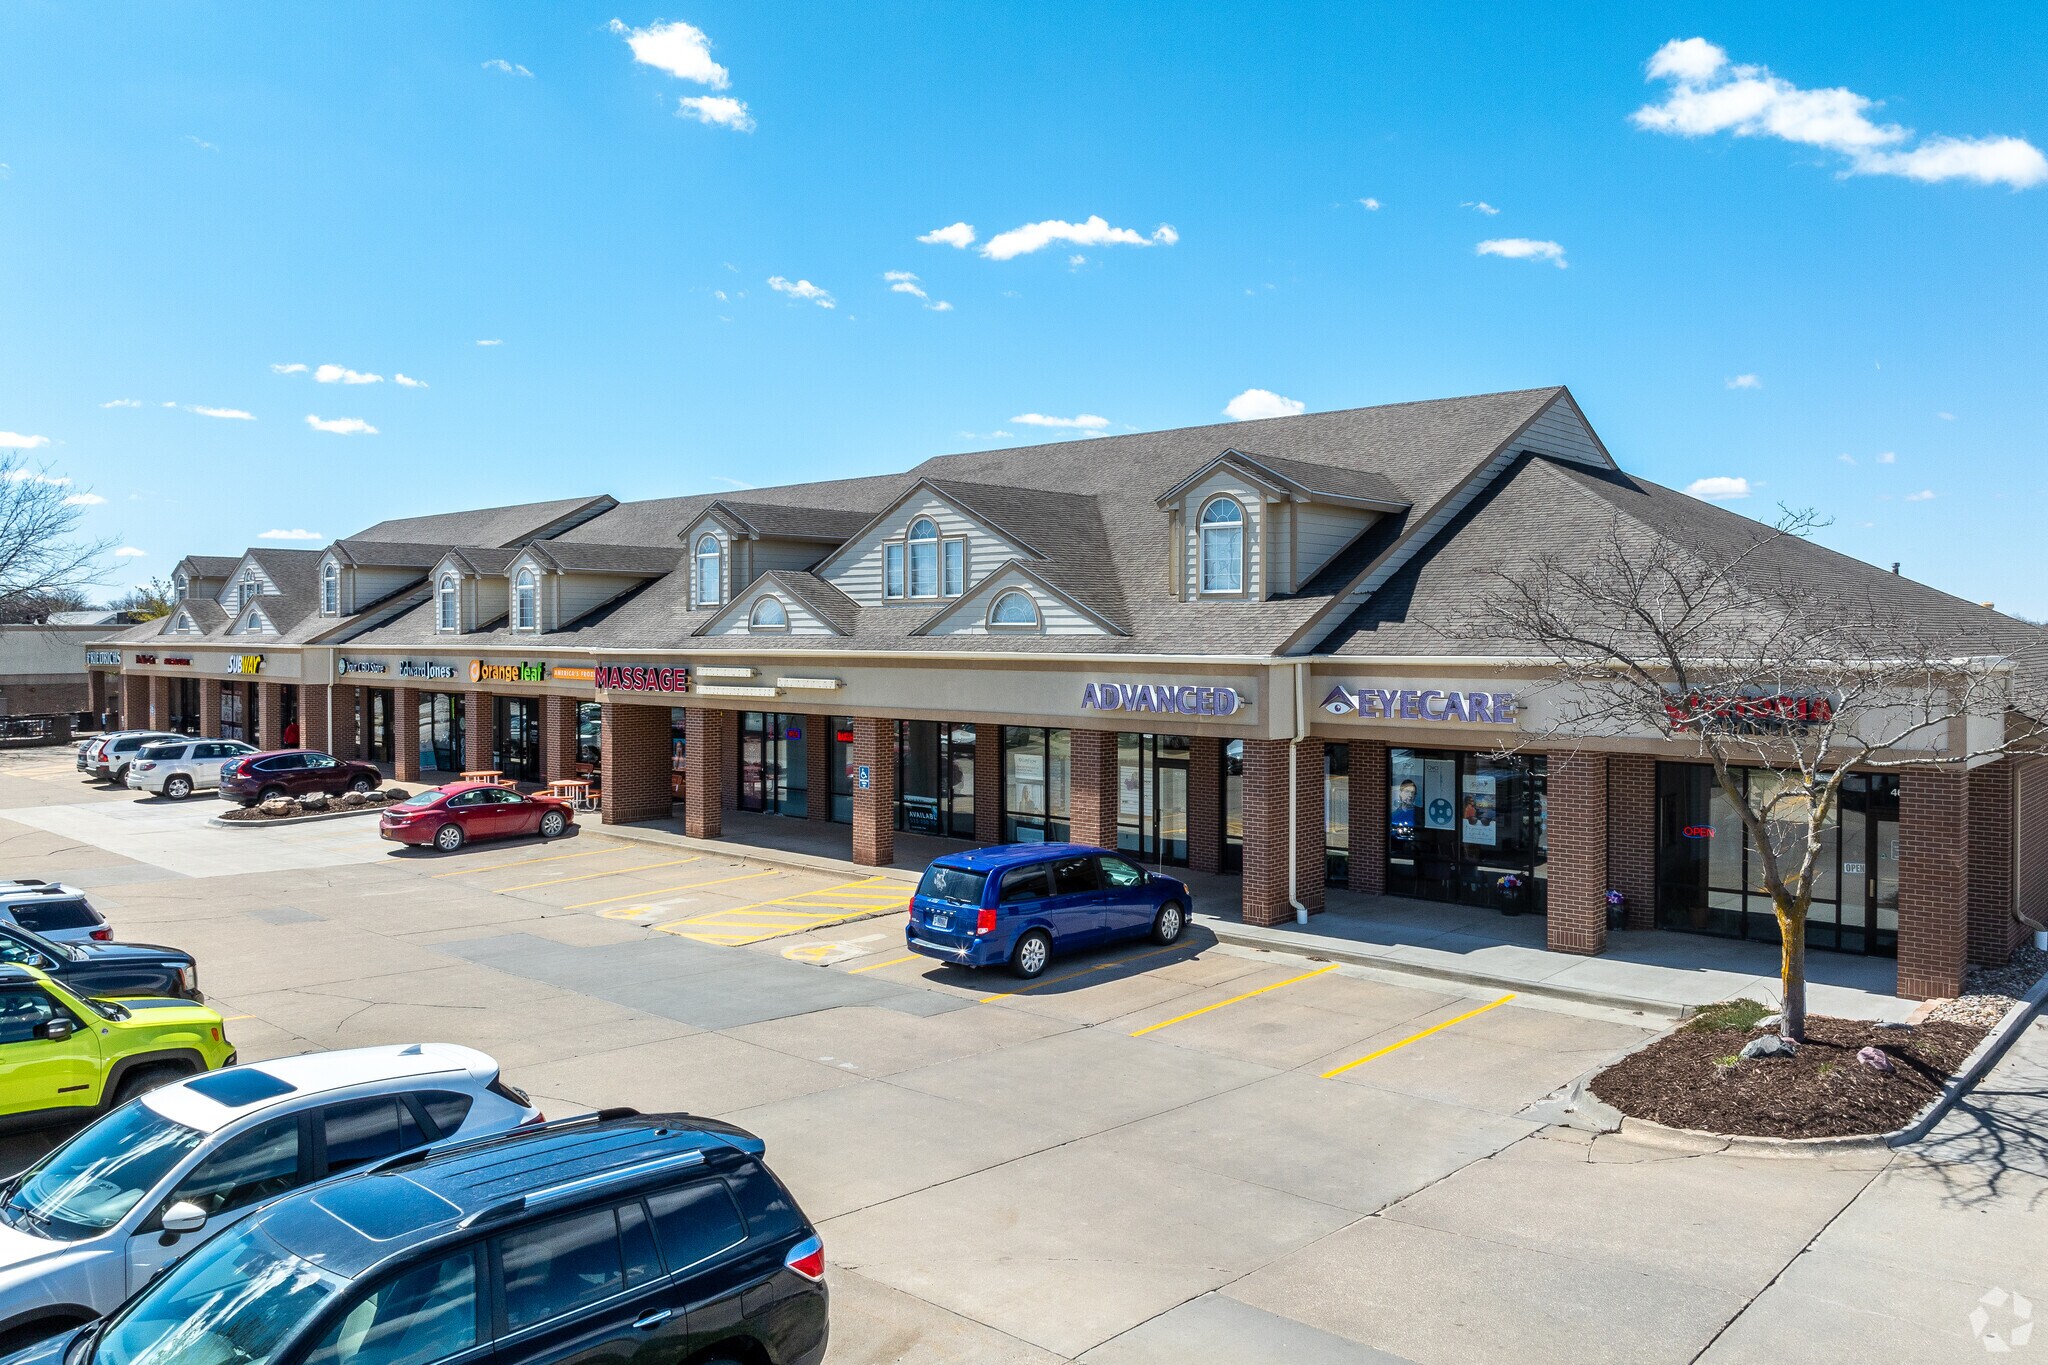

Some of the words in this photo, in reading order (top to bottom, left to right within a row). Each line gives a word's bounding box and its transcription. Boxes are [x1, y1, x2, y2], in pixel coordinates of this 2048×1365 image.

[227, 655, 260, 674] SUBWAY
[358, 662, 370, 673] CBD
[370, 662, 384, 674] Store
[399, 661, 426, 678] Edward
[426, 662, 451, 679] Jones
[481, 663, 519, 682] orange
[521, 661, 543, 681] leaf
[554, 669, 579, 678] AMERICA'S
[594, 665, 686, 692] MASSAGE
[1081, 682, 1239, 717] ADVANCED
[1357, 688, 1517, 724] EYECARE
[909, 811, 937, 821] AVAILABL
[1683, 826, 1715, 838] OPEN
[1845, 863, 1865, 873] OPEN
